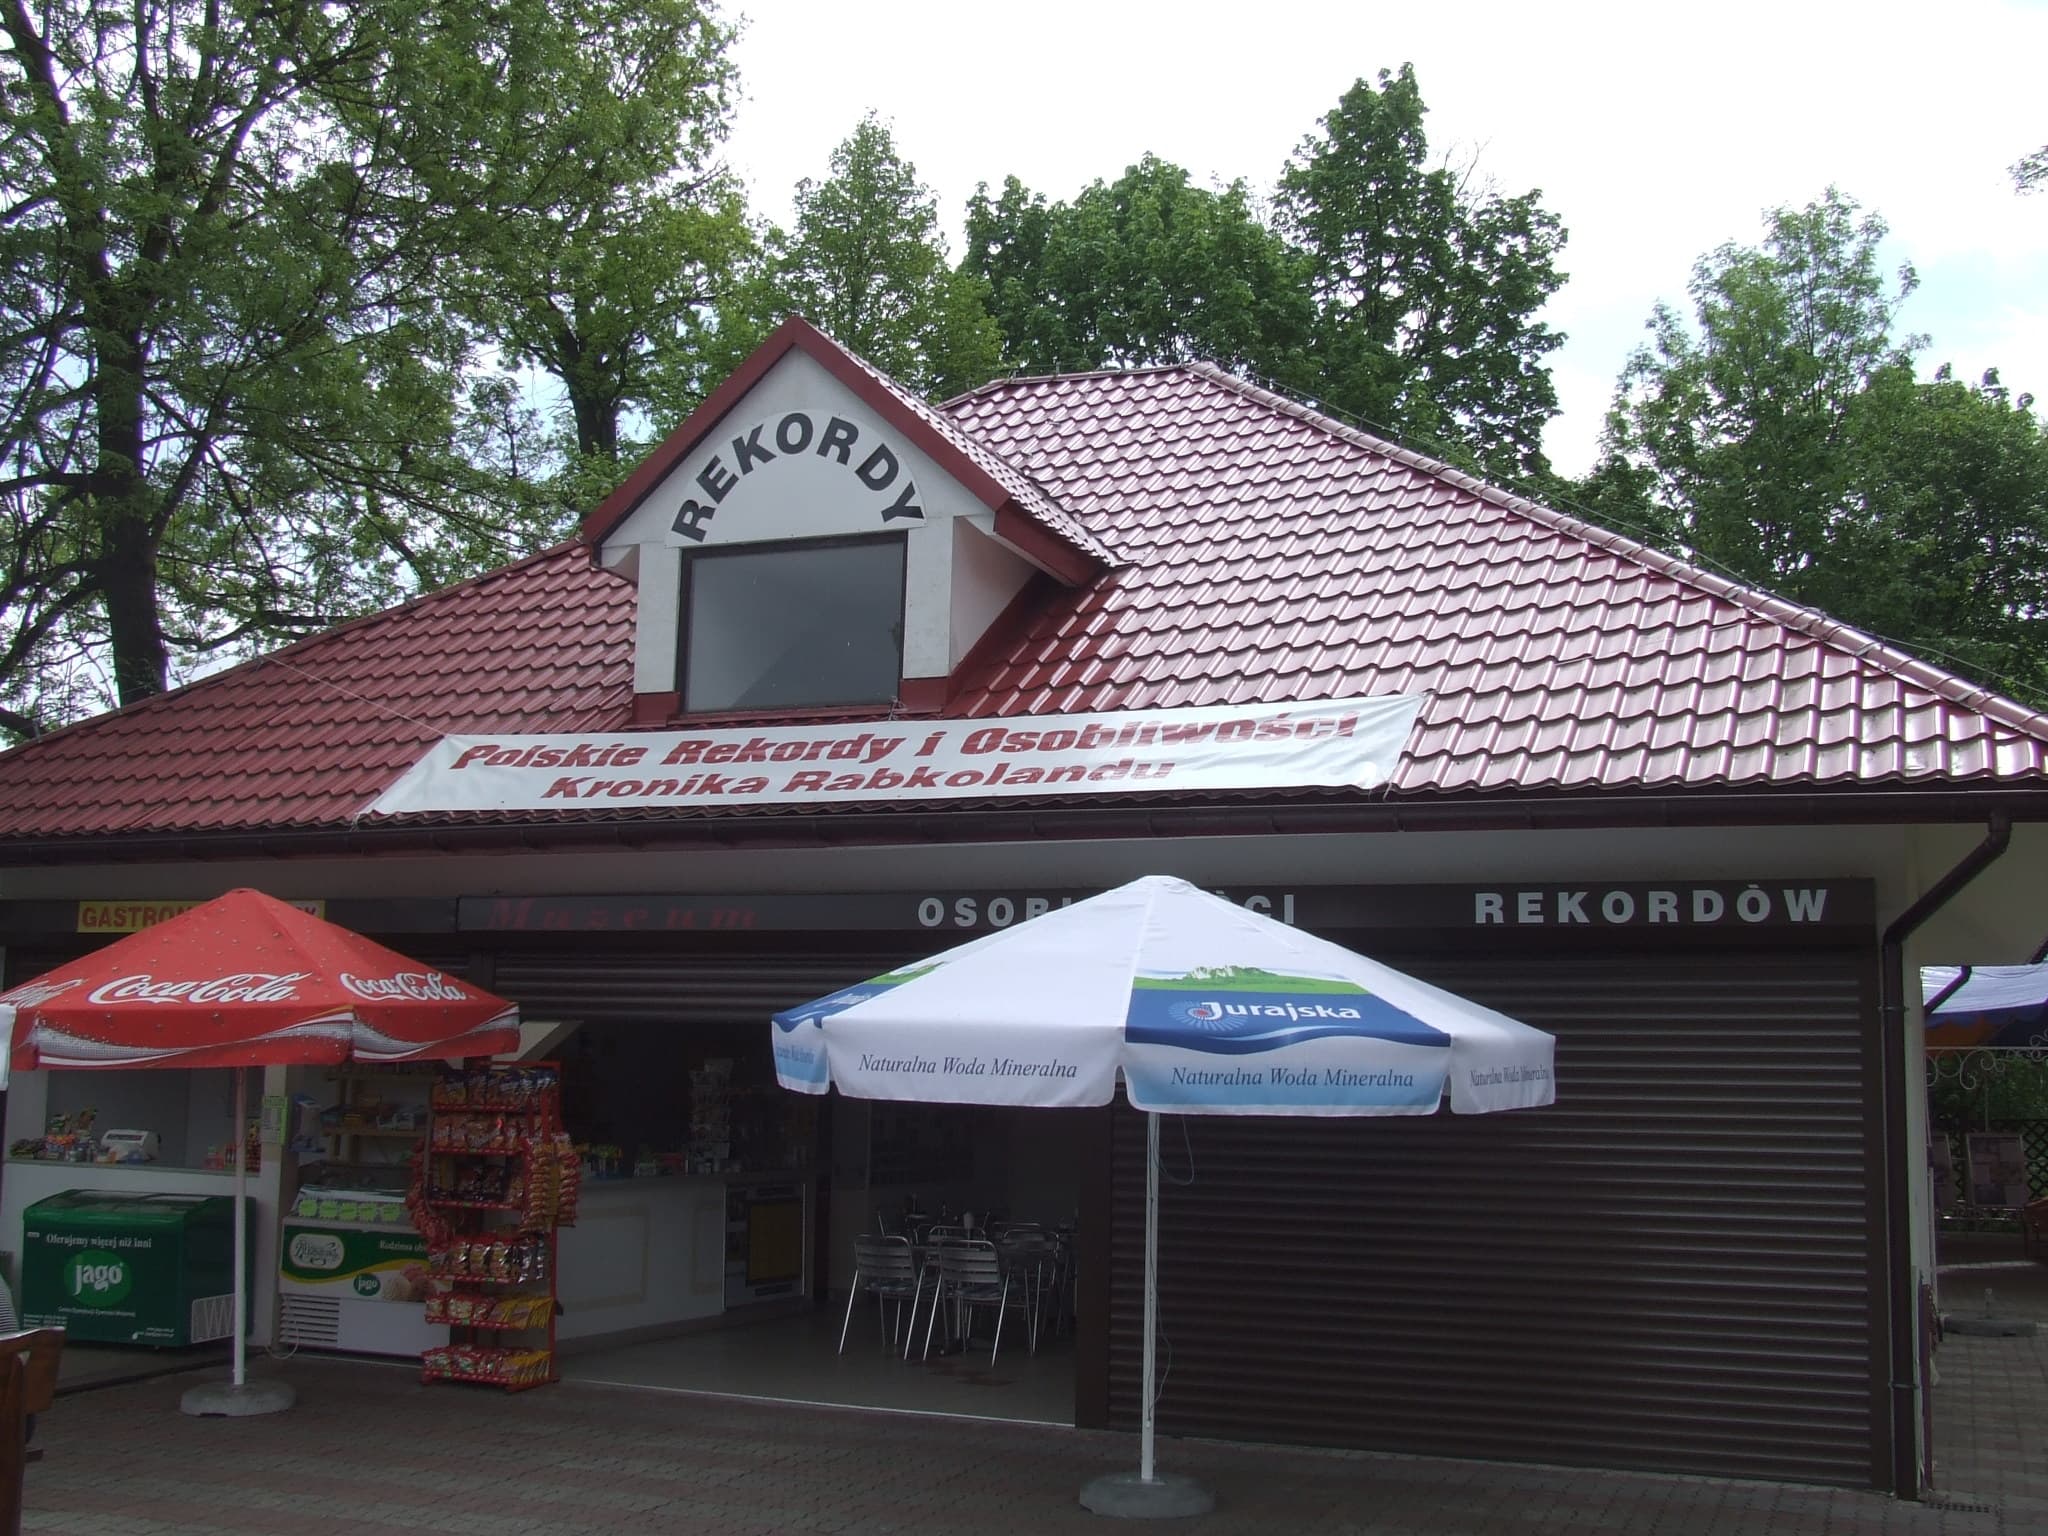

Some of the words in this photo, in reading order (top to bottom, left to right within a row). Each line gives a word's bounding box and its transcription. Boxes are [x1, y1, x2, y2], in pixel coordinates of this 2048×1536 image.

[671, 412, 924, 543] REKORDY
[450, 743, 648, 769] Polskie
[660, 733, 906, 764] Rekordy
[915, 731, 947, 756] i
[960, 711, 1360, 755] Osobliwości
[541, 773, 769, 798] Kronika
[780, 758, 1175, 793] Rabkolandu
[1198, 1001, 1361, 1022] Jurajska
[858, 1053, 937, 1074] Naturalna
[943, 1056, 985, 1076] Woda
[990, 1058, 1078, 1079] Mineralna
[1171, 1067, 1263, 1086] Naturalna
[1270, 1068, 1317, 1086] Woda
[1324, 1068, 1414, 1088] Mineralna
